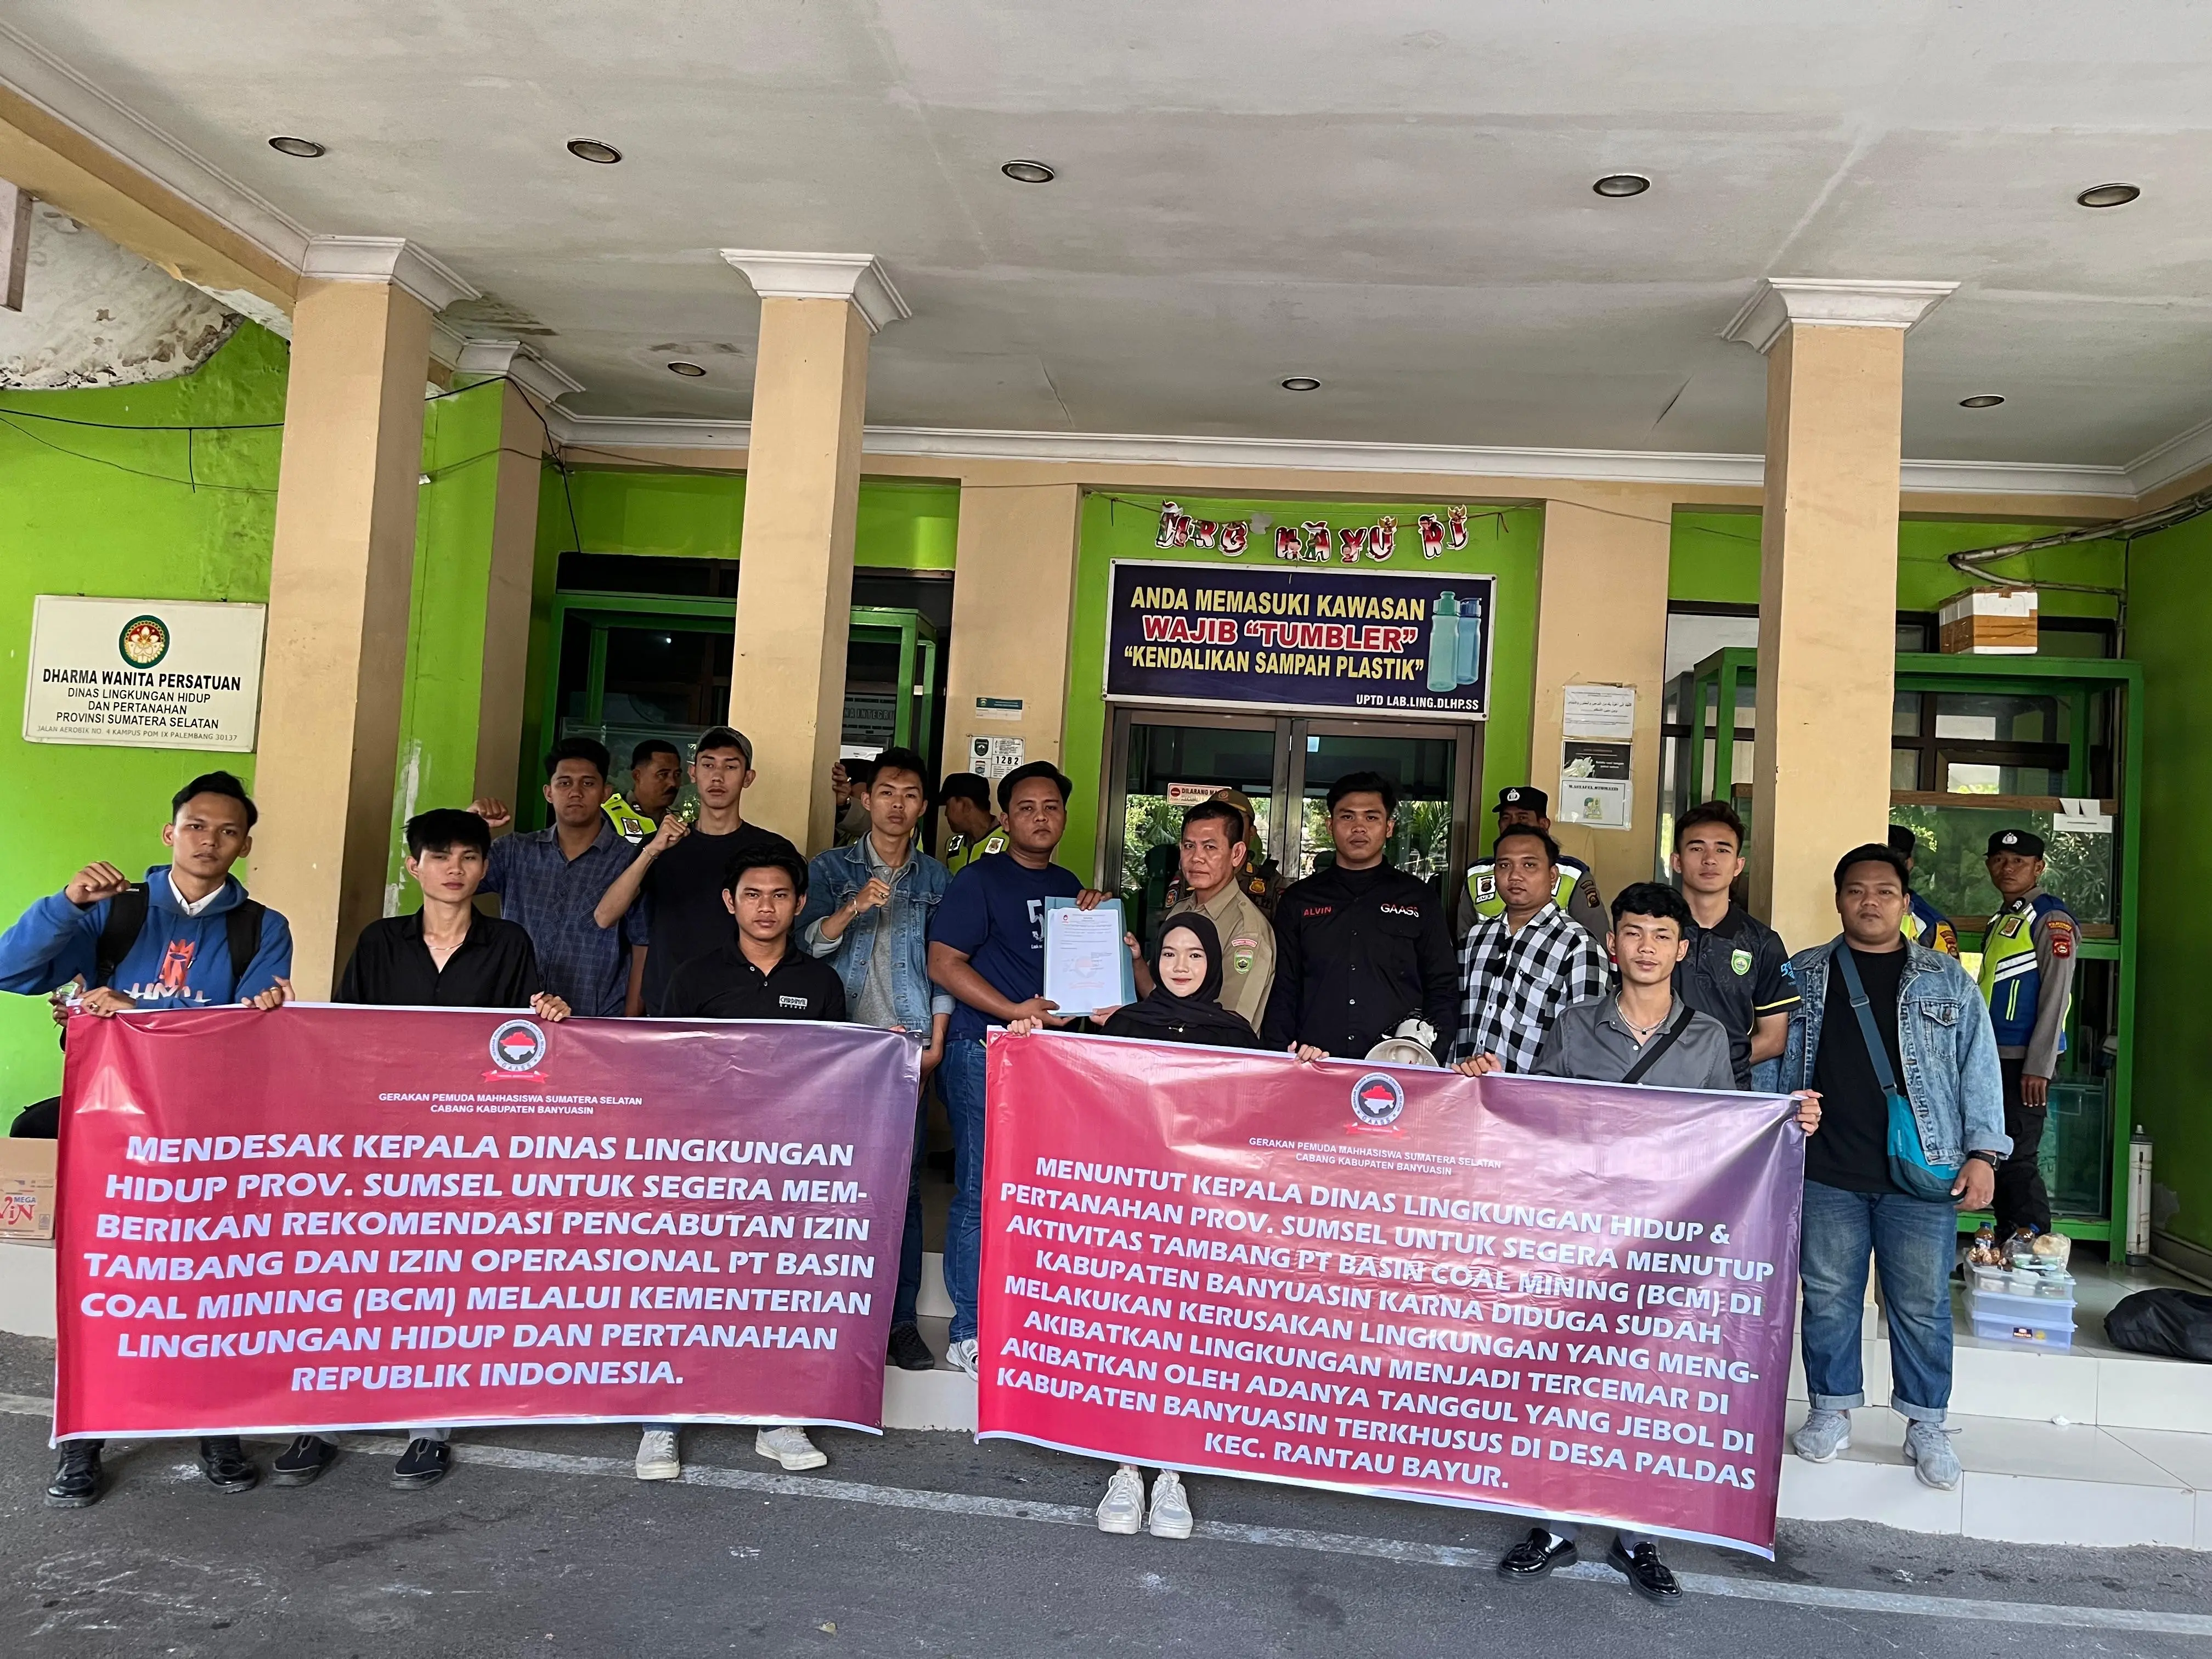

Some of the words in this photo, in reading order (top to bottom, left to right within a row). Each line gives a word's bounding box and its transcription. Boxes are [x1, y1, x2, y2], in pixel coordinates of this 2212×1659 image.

[1131, 586, 1188, 610] ANDA
[1195, 589, 1310, 616] MEMASUKI
[1317, 595, 1425, 620] KAWASAN
[1142, 615, 1238, 645] WAJIB
[1255, 651, 1330, 676] SAMPAH
[43, 669, 98, 684] DHARMA
[102, 670, 154, 687] WANITA
[159, 673, 241, 691] PERSATUAN
[68, 687, 99, 698] DINAS
[102, 690, 174, 702] LINGKUNGAN
[178, 692, 211, 703] HIDUP
[88, 701, 110, 711] DAN
[113, 702, 187, 715] PERTANAHAN
[1356, 694, 1384, 706] UPTD
[1386, 696, 1479, 710] LAB.LING.DLHP.SS
[56, 712, 104, 723] PROVINSI
[108, 715, 166, 726] SUMATERA
[170, 717, 219, 729] SELATAN
[170, 732, 213, 740] PALEMBANG
[996, 756, 1019, 765] 1282
[1304, 906, 1331, 916] ALVIN
[1381, 904, 1419, 917] GAASS
[379, 1093, 430, 1102] GERAKAN
[432, 1094, 475, 1102] PEMUDA
[477, 1094, 543, 1103] MAHHASISWA
[545, 1096, 598, 1104] SUMATERA
[600, 1097, 642, 1105] SELATAN
[431, 1104, 474, 1113] CABANG
[476, 1105, 535, 1114] KABUPATEN
[538, 1106, 594, 1115] BANYUASIN
[1362, 1116, 1390, 1125] GAASS
[126, 1134, 342, 1163] MENDESAK
[354, 1135, 500, 1159] KEPALA
[509, 1136, 617, 1160] DINAS
[625, 1138, 854, 1166] LINGKUNGAN
[1249, 1137, 1295, 1149] GERAKAN
[1297, 1142, 1336, 1153] PEMUDA
[1339, 1146, 1402, 1159] MAHHASISWA
[1404, 1152, 1455, 1164] SUMATERA
[1458, 1156, 1502, 1169] SELATAN
[1296, 1153, 1335, 1164] CABANG
[1338, 1157, 1394, 1170] KABUPATEN
[1397, 1163, 1452, 1175] BANYUASIN
[105, 1175, 227, 1203] HIDUP
[237, 1173, 353, 1199] PROV.
[363, 1173, 502, 1197] SUMSEL
[511, 1174, 634, 1198] UNTUK
[642, 1175, 772, 1201] SEGERA
[781, 1180, 867, 1204] MEM-
[1036, 1157, 1187, 1192] MENUNTUT
[1192, 1175, 1302, 1204] KEPALA
[1310, 1185, 1396, 1214] DINAS
[1404, 1195, 1601, 1235] LINGKUNGAN
[1610, 1215, 1703, 1242] HIDUP
[1710, 1223, 1730, 1245] &
[96, 1213, 272, 1242] BERIKAN
[282, 1212, 552, 1237] REKOMENDASI
[562, 1212, 793, 1239] PENCABUTAN
[803, 1217, 870, 1241] IZIN
[1001, 1183, 1182, 1224] PERTANAHAN
[1190, 1207, 1273, 1234] PROV.
[1282, 1216, 1387, 1245] SUMSEL
[1395, 1226, 1495, 1256] UNTUK
[1503, 1237, 1622, 1269] SEGERA
[1626, 1252, 1774, 1283] MENUTUP
[83, 1251, 283, 1281] TAMBANG
[294, 1250, 379, 1274] DAN
[388, 1250, 462, 1273] IZIN
[472, 1249, 720, 1274] OPERASIONAL
[729, 1251, 769, 1274] PT
[776, 1252, 875, 1279] BASIN
[1006, 1215, 1142, 1251] AKTIVITAS
[1150, 1234, 1290, 1269] TAMBANG
[1297, 1250, 1332, 1273] PT
[1339, 1253, 1424, 1282] BASIN
[1432, 1265, 1511, 1291] COAL
[1519, 1273, 1628, 1302] MINING
[1637, 1284, 1720, 1317] (BCM)
[1730, 1293, 1762, 1316] DI
[81, 1293, 187, 1319] COAL
[197, 1289, 342, 1319] MINING
[354, 1287, 455, 1319] (BCM)
[467, 1286, 620, 1311] MELALUI
[629, 1286, 872, 1316] KEMENTERIAN
[1036, 1250, 1199, 1290] KABUPATEN
[1206, 1273, 1371, 1309] BANYUASIN
[1379, 1291, 1483, 1321] KARNA
[1491, 1303, 1607, 1333] DIDUGA
[1617, 1314, 1720, 1345] SUDAH
[117, 1327, 381, 1358] LINGKUNGAN
[391, 1325, 504, 1350] HIDUP
[513, 1324, 592, 1348] DAN
[601, 1323, 838, 1350] PERTANAHAN
[1005, 1276, 1171, 1317] MELAKUKAN
[1179, 1301, 1351, 1340] KERUSAKAN
[1361, 1322, 1558, 1361] LINGKUNGAN
[1565, 1344, 1650, 1370] YANG
[1658, 1353, 1759, 1383] MENG-
[291, 1364, 471, 1391] REPUBLIK
[479, 1361, 684, 1387] INDONESIA.
[1024, 1310, 1182, 1351] AKIBATKAN
[1189, 1335, 1380, 1377] LINGKUNGAN
[1389, 1358, 1520, 1390] MENJADI
[1528, 1373, 1689, 1409] TERCEMAR
[1697, 1391, 1729, 1414] DI
[1001, 1338, 1157, 1380] AKIBATKAN
[1164, 1364, 1239, 1391] OLEH
[1246, 1376, 1369, 1408] ADANYA
[1379, 1391, 1518, 1423] TANGGUL
[1525, 1404, 1610, 1433] YANG
[1617, 1416, 1714, 1447] JEBOL
[1723, 1432, 1754, 1454] DI
[997, 1368, 1156, 1413] KABUPATEN
[1164, 1396, 1327, 1435] BANYUASIN
[1335, 1418, 1503, 1453] TERKHUSUS
[1511, 1438, 1540, 1459] DI
[1549, 1443, 1628, 1470] DESA
[1635, 1452, 1756, 1489] PALDAS
[1205, 1432, 1265, 1459] KEC.
[1273, 1441, 1395, 1474] RANTAU
[1403, 1457, 1509, 1488] BAYUR.
